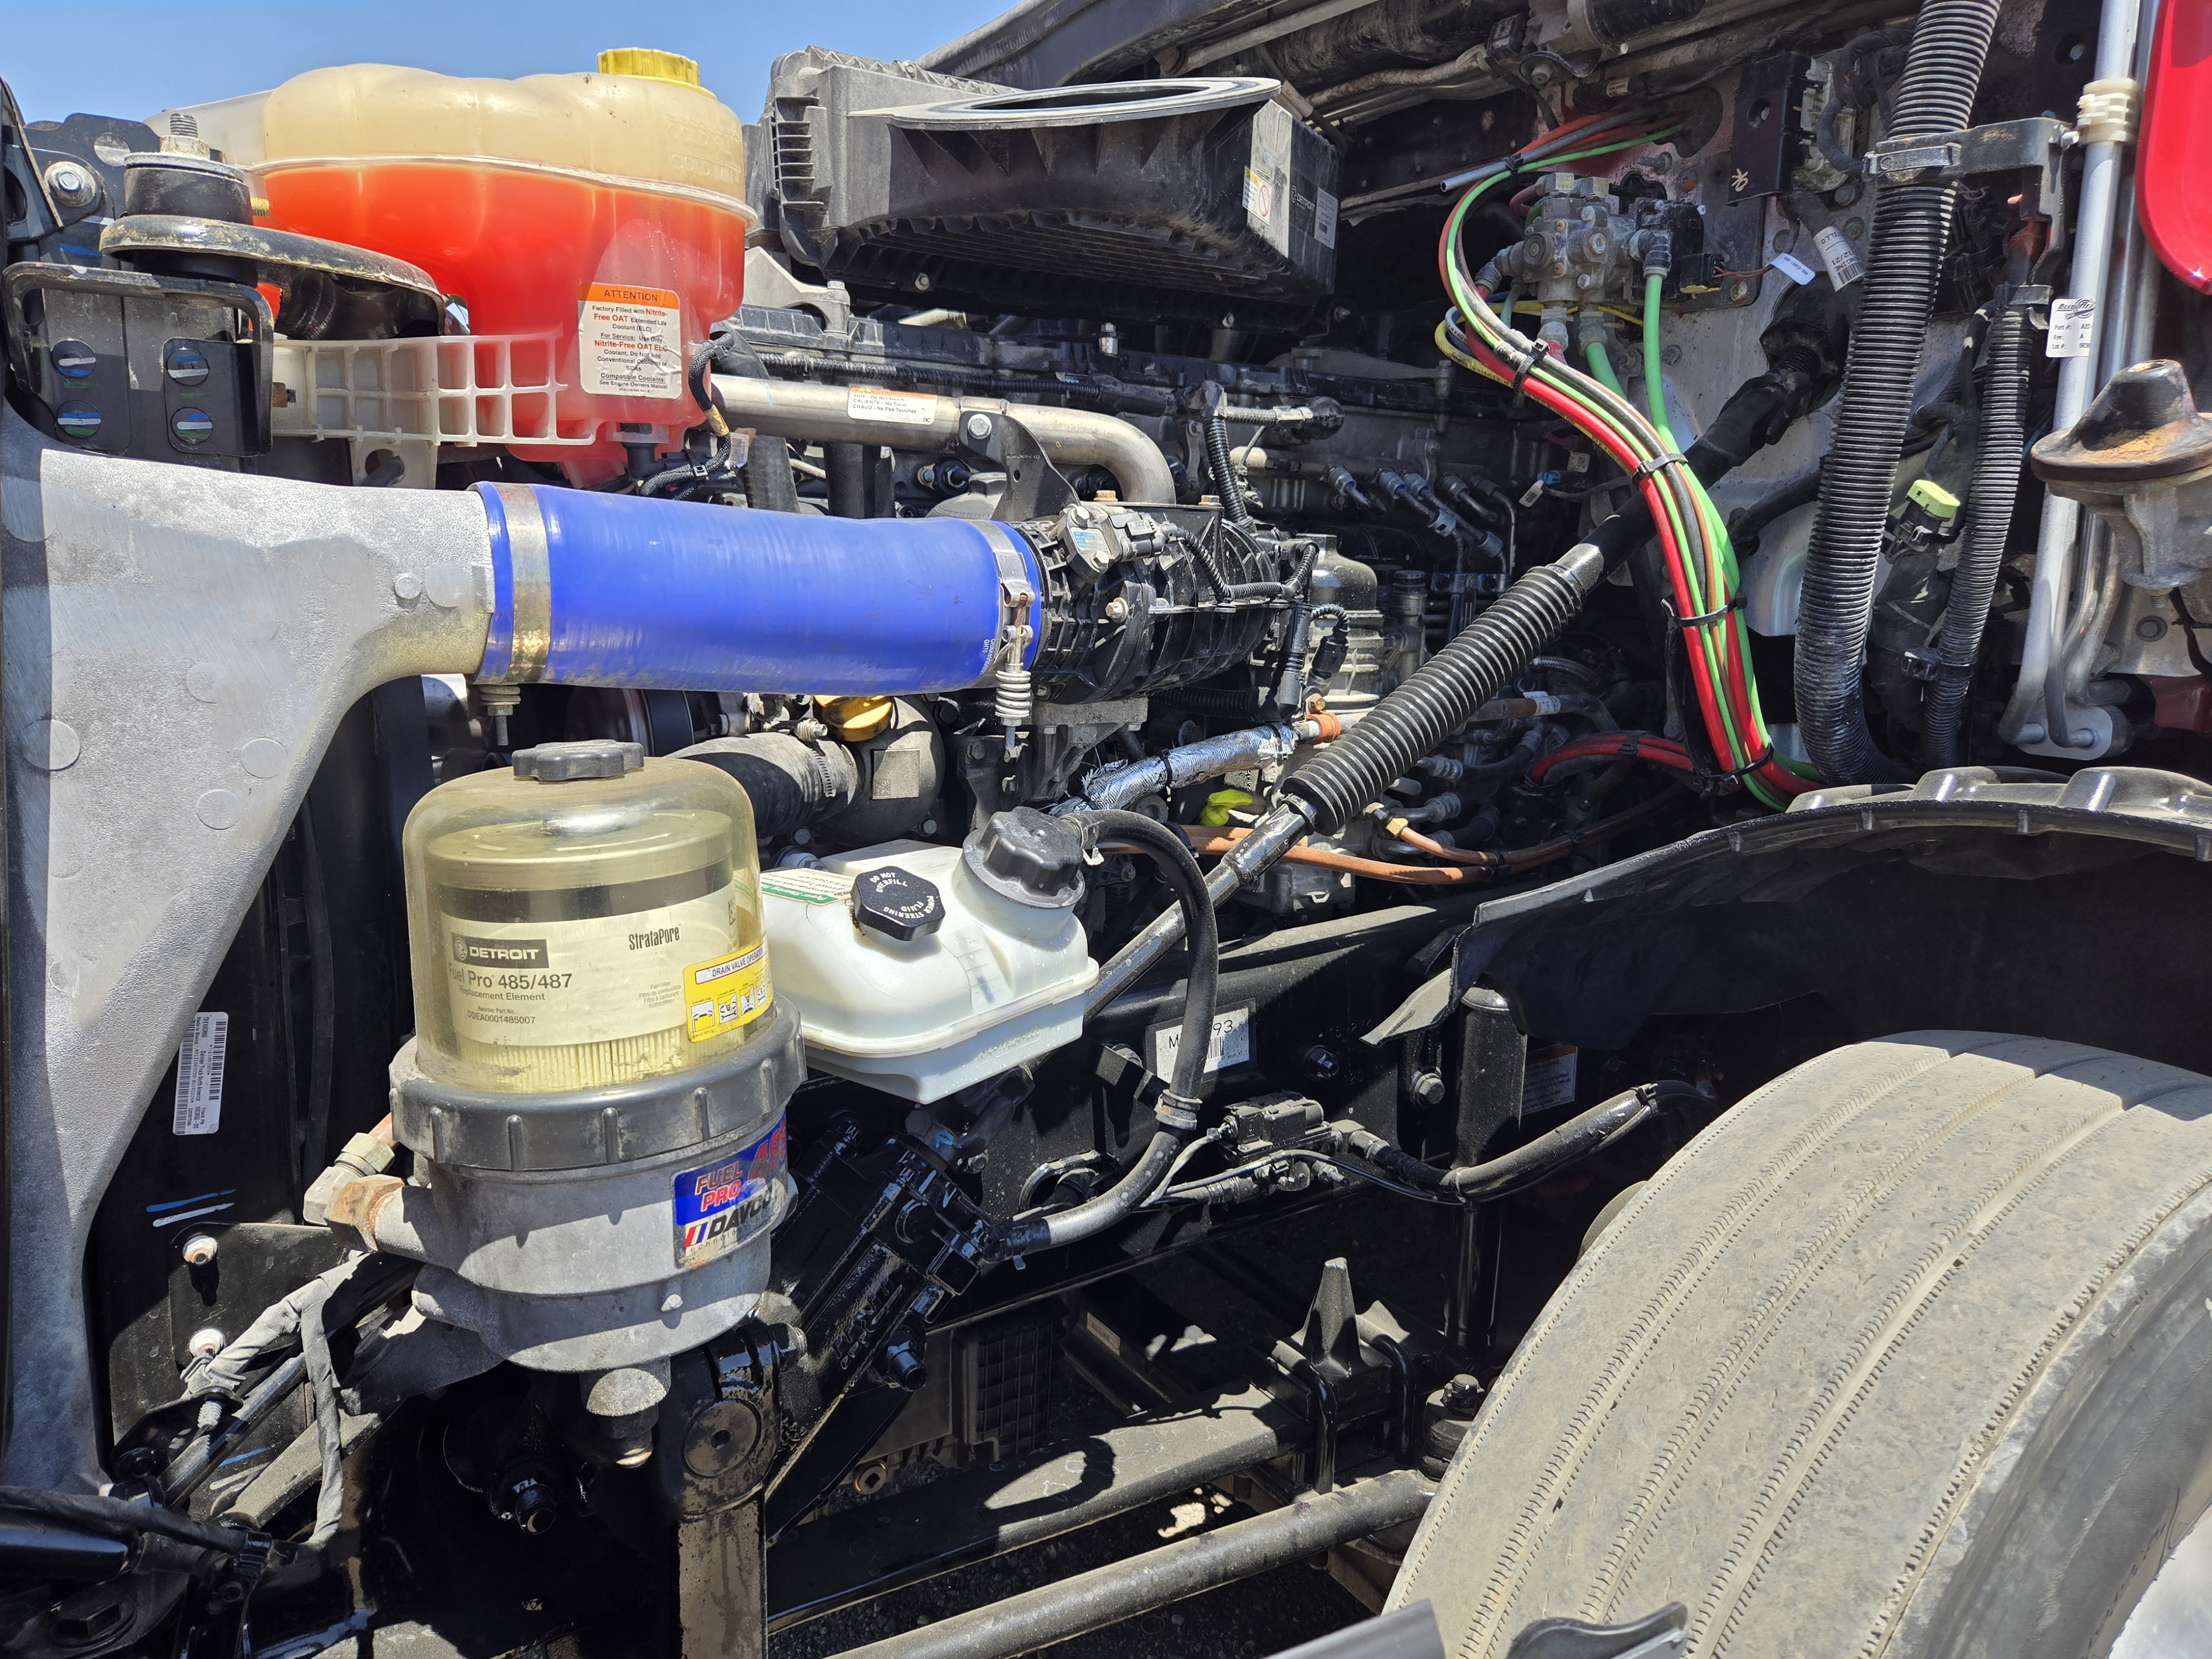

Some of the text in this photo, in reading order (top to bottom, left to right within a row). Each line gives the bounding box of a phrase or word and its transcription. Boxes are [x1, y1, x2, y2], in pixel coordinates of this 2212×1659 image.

[604, 289, 658, 301] ATTENTION
[645, 309, 668, 317] Nitrite-
[594, 340, 635, 349] Nitrite-Free
[875, 879, 907, 893] OVERFILL
[883, 895, 935, 919] POWER STEERING
[900, 901, 925, 912] FLUID
[629, 926, 680, 951] StrataPore
[469, 946, 539, 960] DETROIT
[712, 964, 731, 977] DRAIN
[732, 959, 745, 971] VALVE
[448, 962, 572, 990] Fuel Pro 485/487
[459, 985, 546, 1001] Replacement Element
[467, 1010, 536, 1024] DDEA0001485007
[695, 1161, 743, 1195] FUEL
[701, 1180, 742, 1212] PRO
